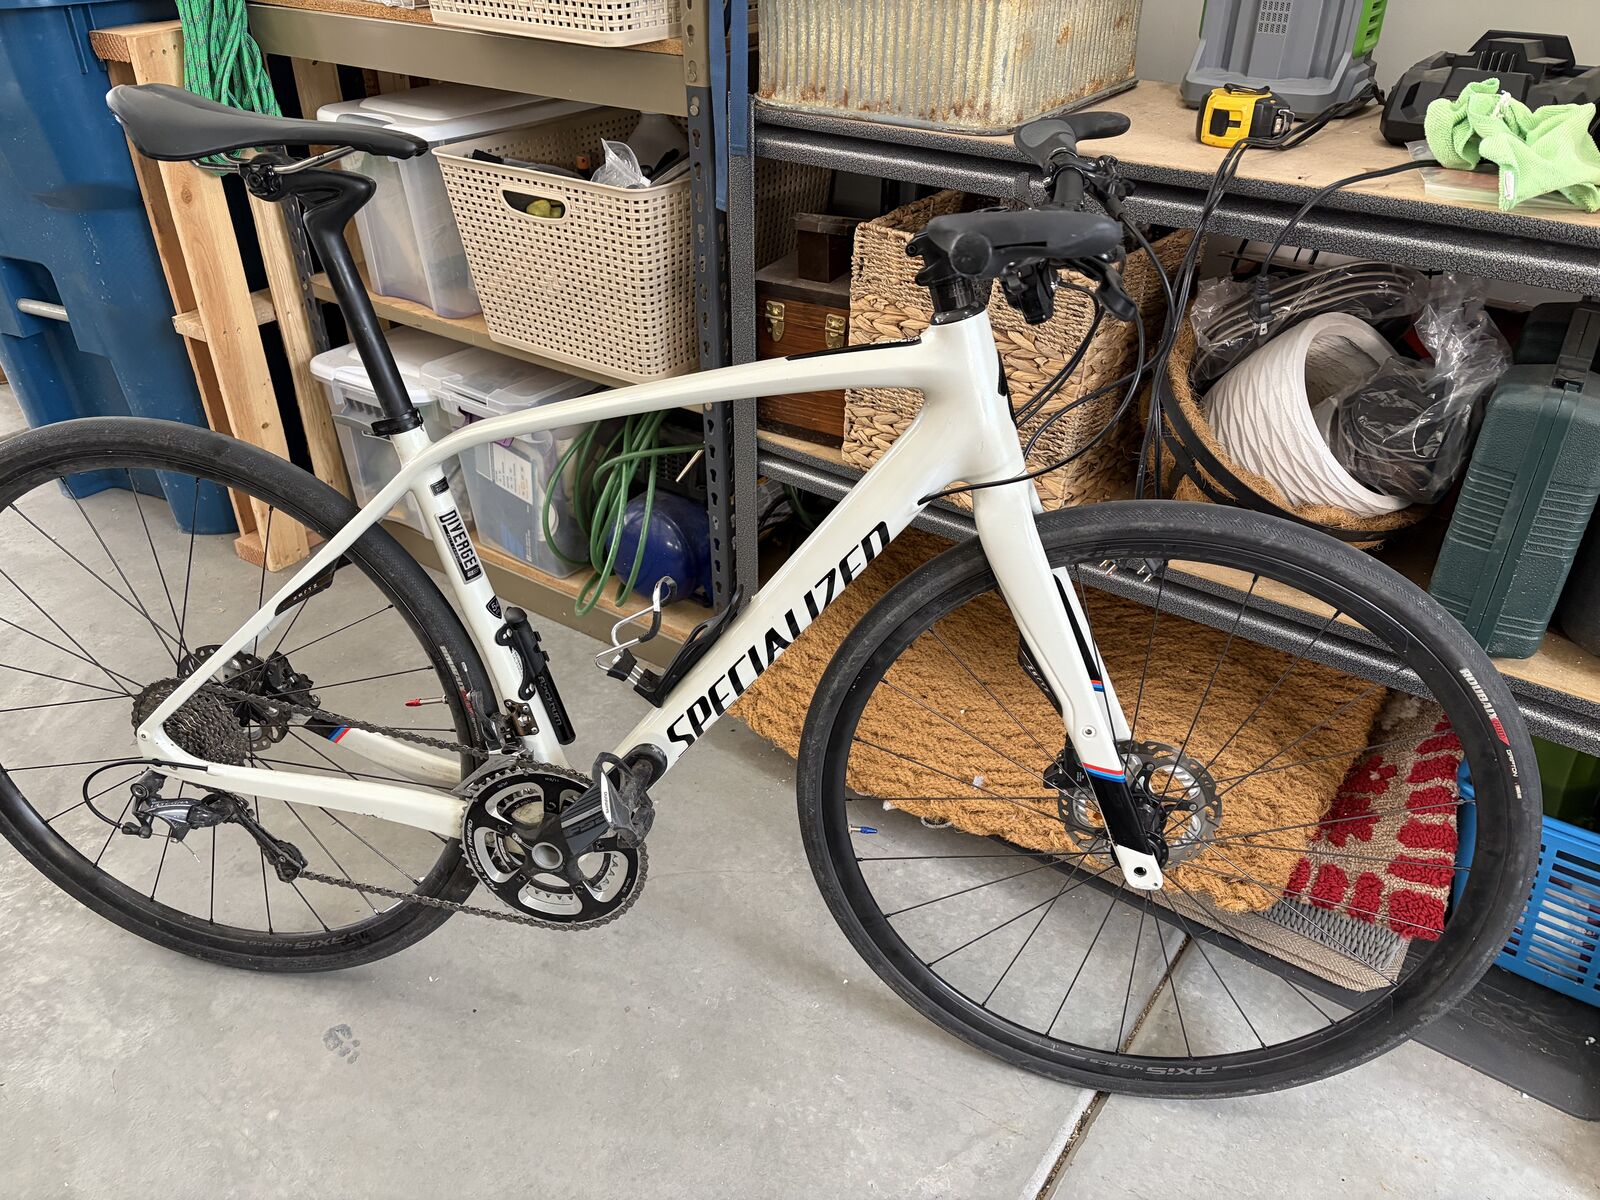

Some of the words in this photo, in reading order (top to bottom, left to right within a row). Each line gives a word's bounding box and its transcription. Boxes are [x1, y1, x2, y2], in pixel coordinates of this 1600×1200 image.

[439, 509, 479, 569] DIVERGE
[666, 520, 891, 747] SPECIALIZED
[1459, 667, 1499, 720] ROUBAIX
[466, 818, 474, 847] AHEAD
[469, 847, 484, 873] SPEED
[482, 873, 499, 891] FULL
